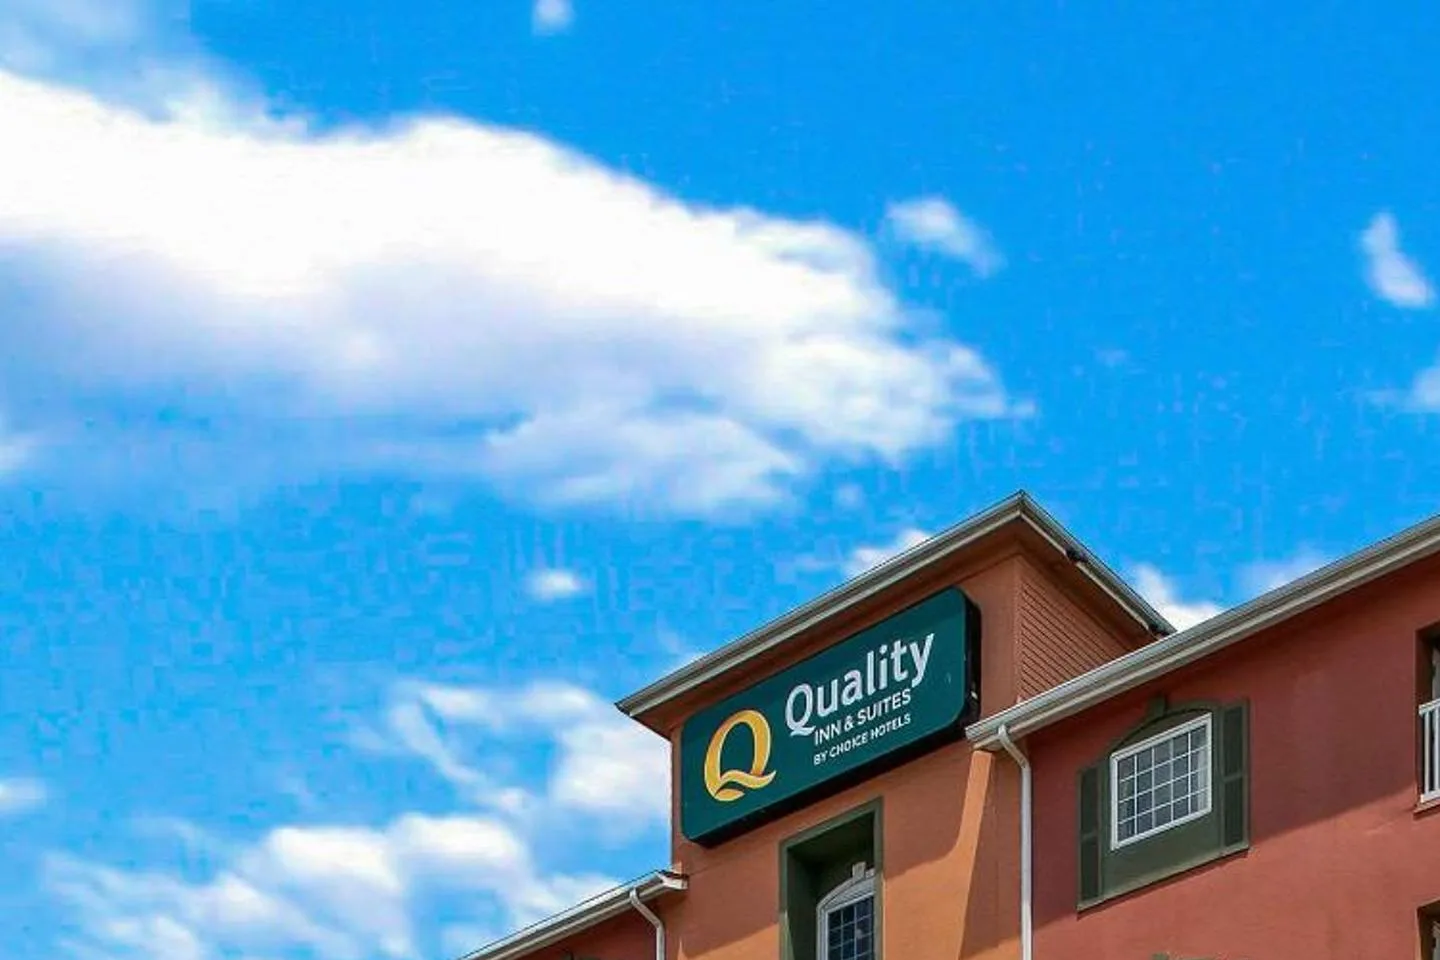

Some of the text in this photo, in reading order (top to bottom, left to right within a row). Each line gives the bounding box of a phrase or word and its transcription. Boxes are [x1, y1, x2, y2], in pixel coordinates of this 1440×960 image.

[784, 632, 935, 737] Quality
[814, 688, 912, 747] INN & SUITES
[703, 709, 777, 802] Q
[813, 713, 912, 766] BY CHOICE HOTELS
